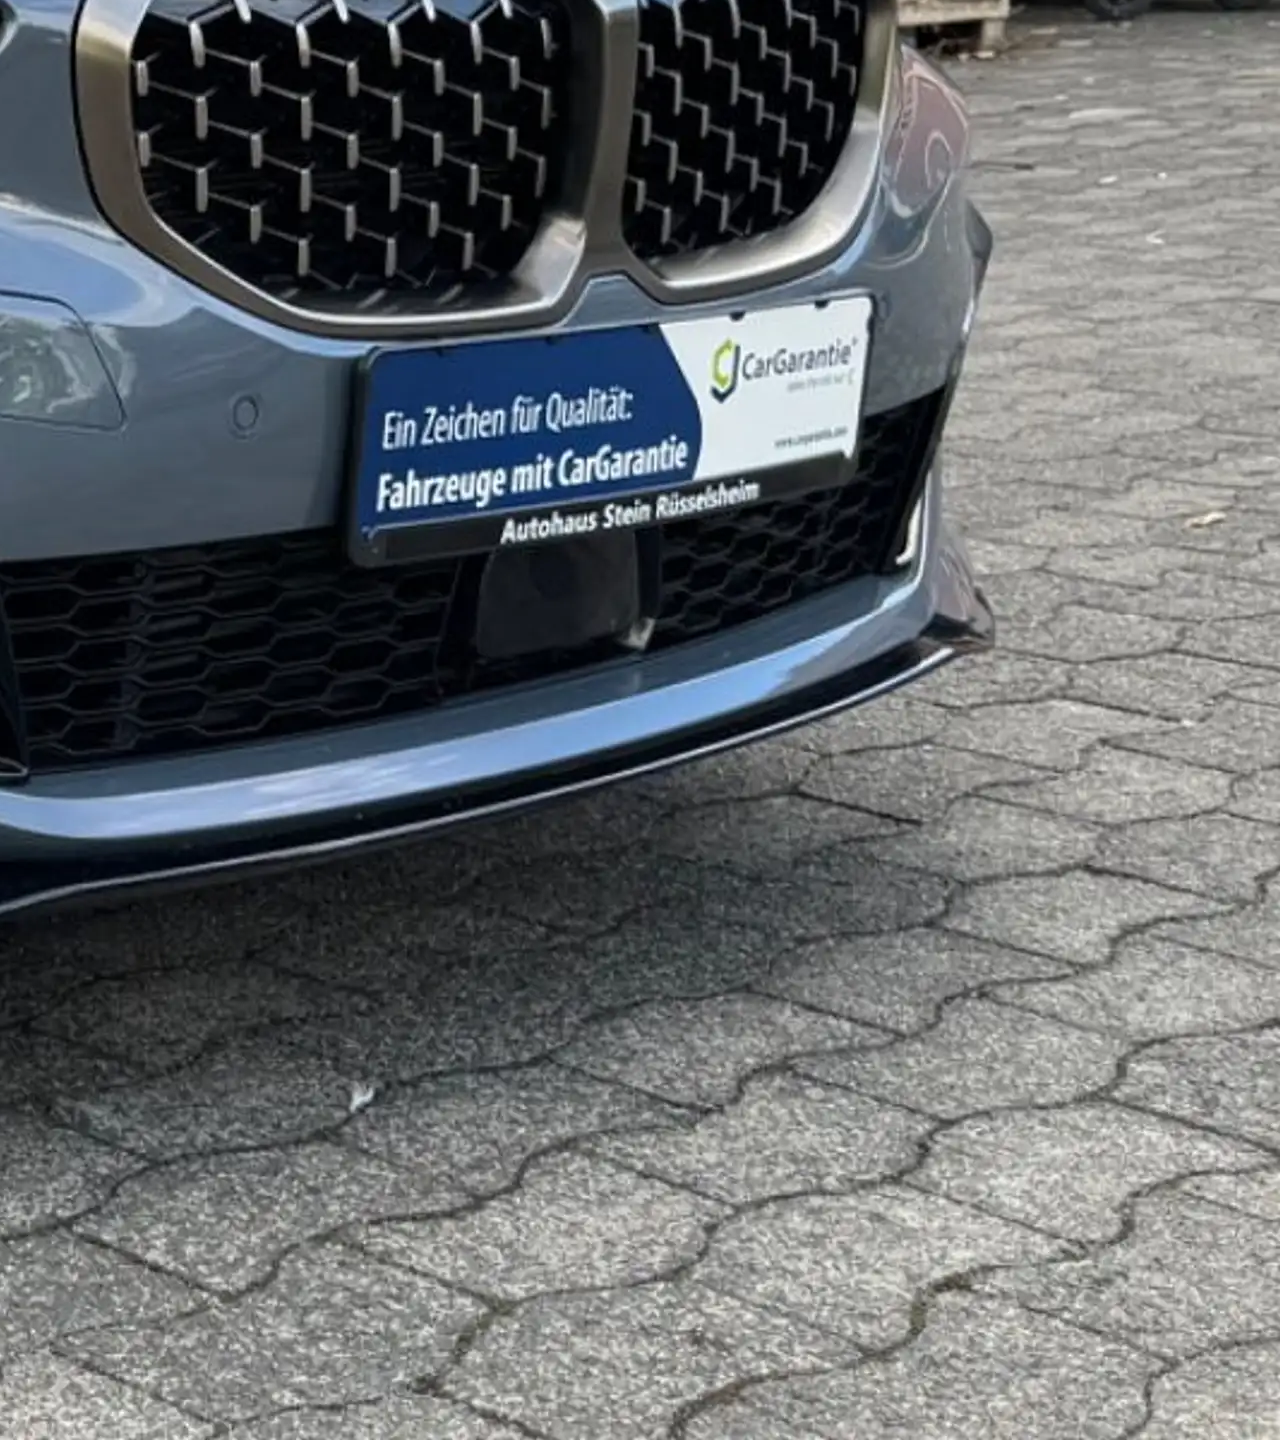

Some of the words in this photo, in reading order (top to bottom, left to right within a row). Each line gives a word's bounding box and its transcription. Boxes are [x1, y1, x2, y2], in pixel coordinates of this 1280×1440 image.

[742, 337, 852, 381] CarGarantie
[382, 410, 416, 450] Ein
[421, 401, 505, 445] Zeichen
[511, 395, 541, 434] für
[546, 386, 634, 433] Qualität:
[377, 469, 507, 511] Fahrzeuge
[511, 453, 553, 493] mit
[557, 435, 689, 486] CarGarantie
[500, 510, 597, 545] Autohaus
[603, 498, 650, 528] Stein
[656, 478, 761, 521] Rüsselsheim
